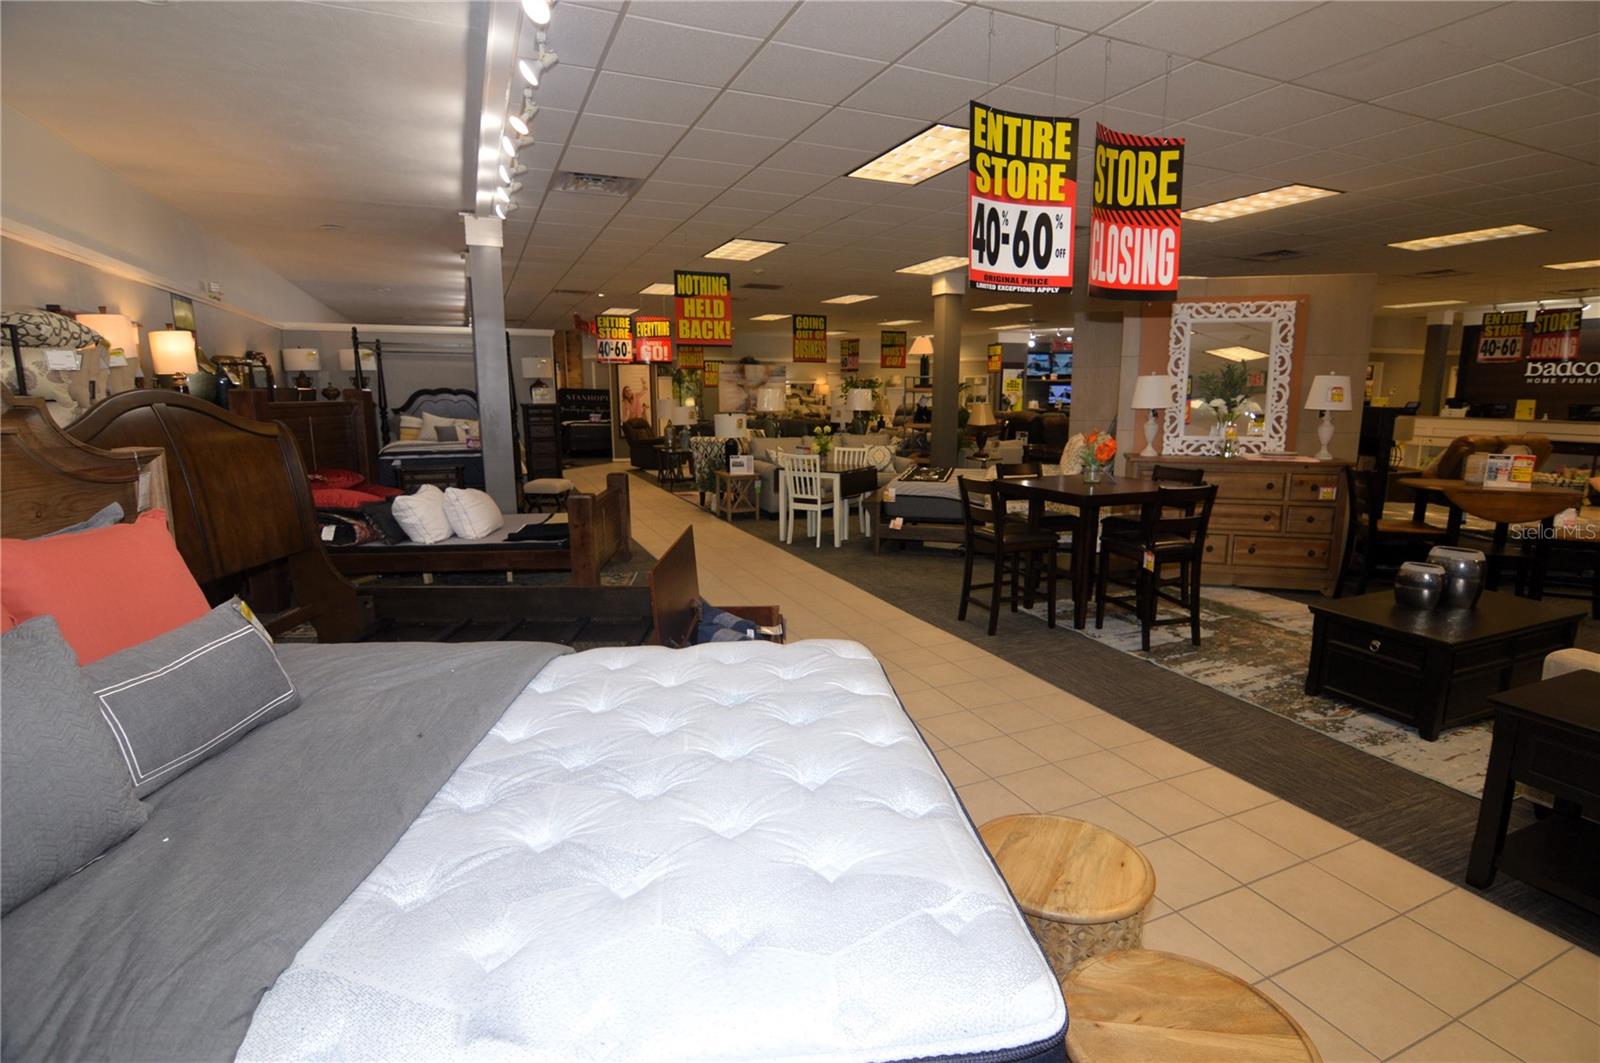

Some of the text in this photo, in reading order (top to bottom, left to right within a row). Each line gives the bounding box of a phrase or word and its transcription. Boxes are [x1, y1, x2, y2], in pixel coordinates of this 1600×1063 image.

[974, 106, 1072, 161] ENTIRE
[975, 152, 1066, 202] STORE
[1095, 143, 1180, 207] STORE
[1055, 248, 1066, 259] OFF
[1090, 219, 1176, 287] CLOSING
[676, 274, 728, 297] NOTHING
[984, 274, 1049, 285] ORIGINAL PRICE
[997, 284, 1036, 293] EXCEPTIONS
[1036, 286, 1060, 295] APPLY
[683, 298, 725, 319] HELD
[596, 316, 631, 328] ENTIRE
[796, 316, 825, 330] GOING
[1484, 312, 1527, 325] ENTIRE
[1534, 311, 1582, 334] STORE
[598, 327, 630, 339] STORE
[678, 319, 732, 340] BACK!
[796, 330, 825, 339] OUT OF
[1484, 324, 1523, 337] STORE
[640, 344, 669, 361] GO!
[795, 339, 826, 359] BUSINESS
[1530, 336, 1577, 358] CLOSING
